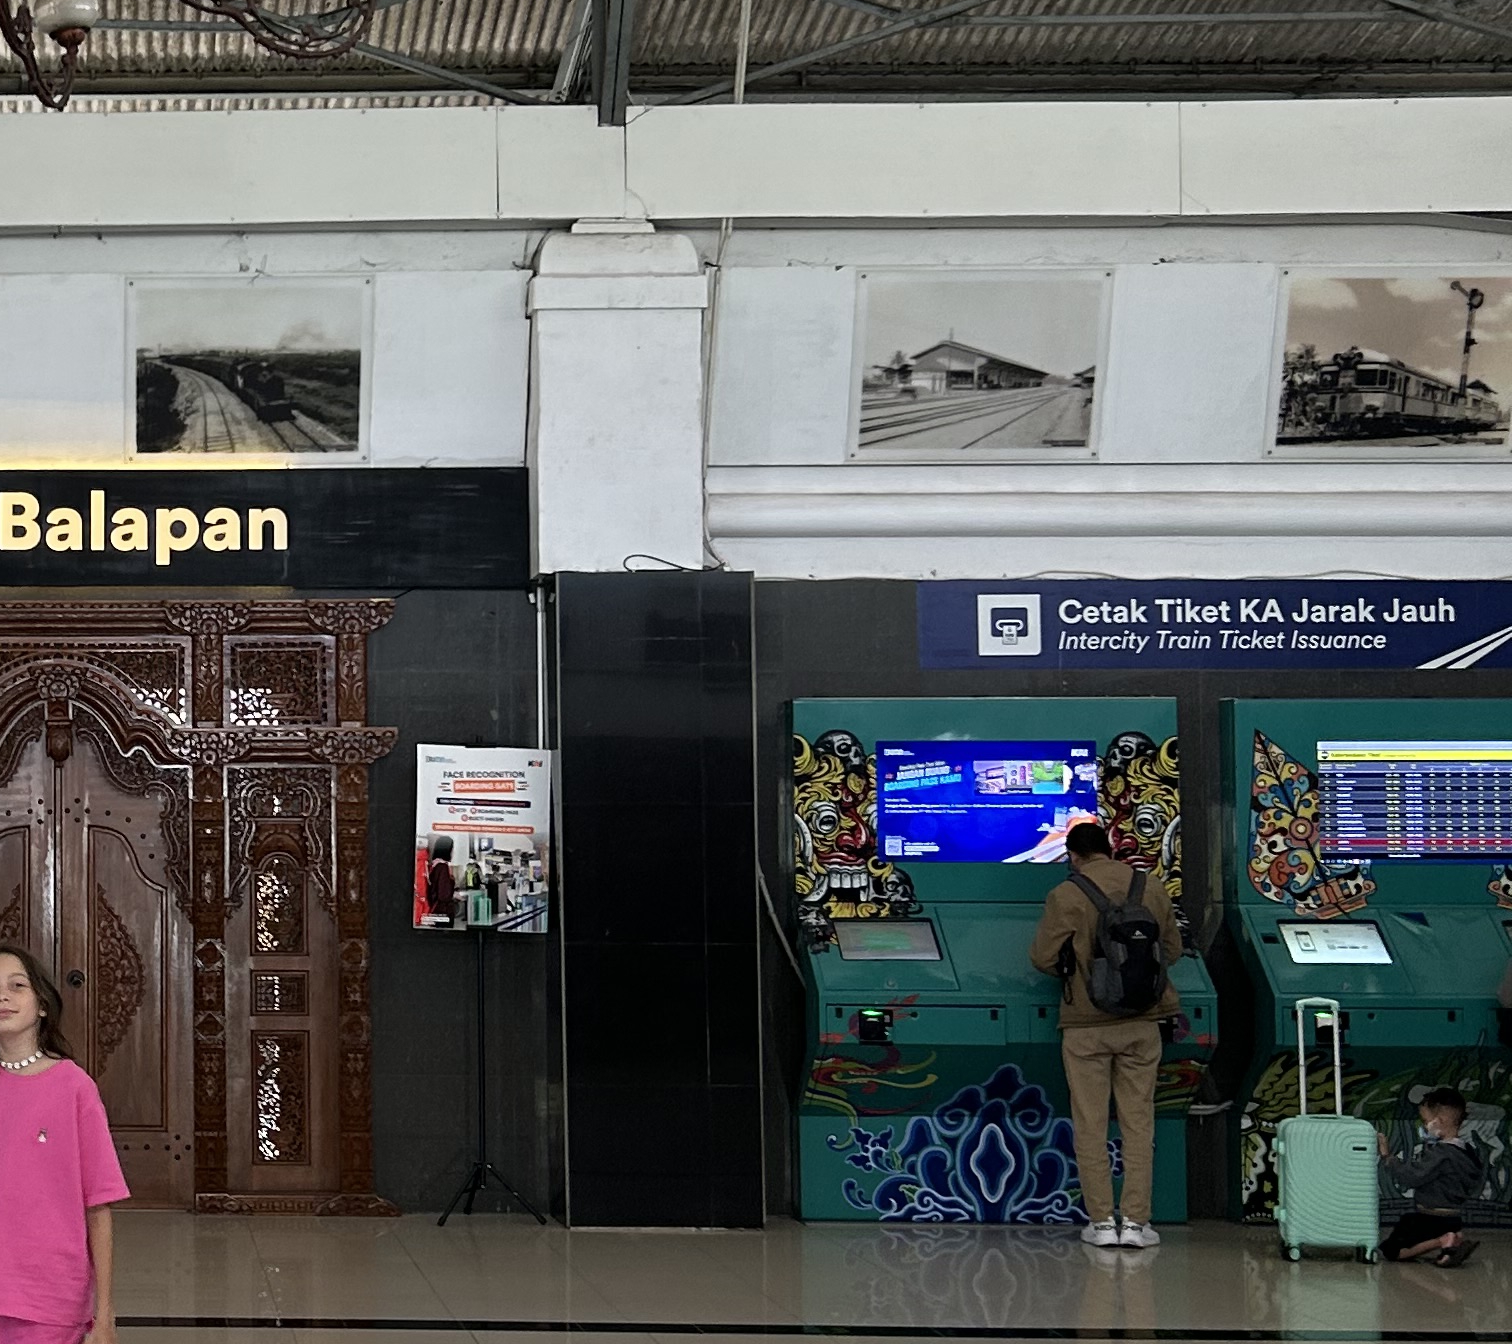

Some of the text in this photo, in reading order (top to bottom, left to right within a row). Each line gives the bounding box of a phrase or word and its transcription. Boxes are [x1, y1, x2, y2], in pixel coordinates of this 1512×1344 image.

[1058, 597, 1456, 624] Cetak Tiket KA Jarak Jauh
[1058, 629, 1387, 654] Intercity Train Ticket Issuance
[443, 770, 526, 779] FACE RECOGNITION
